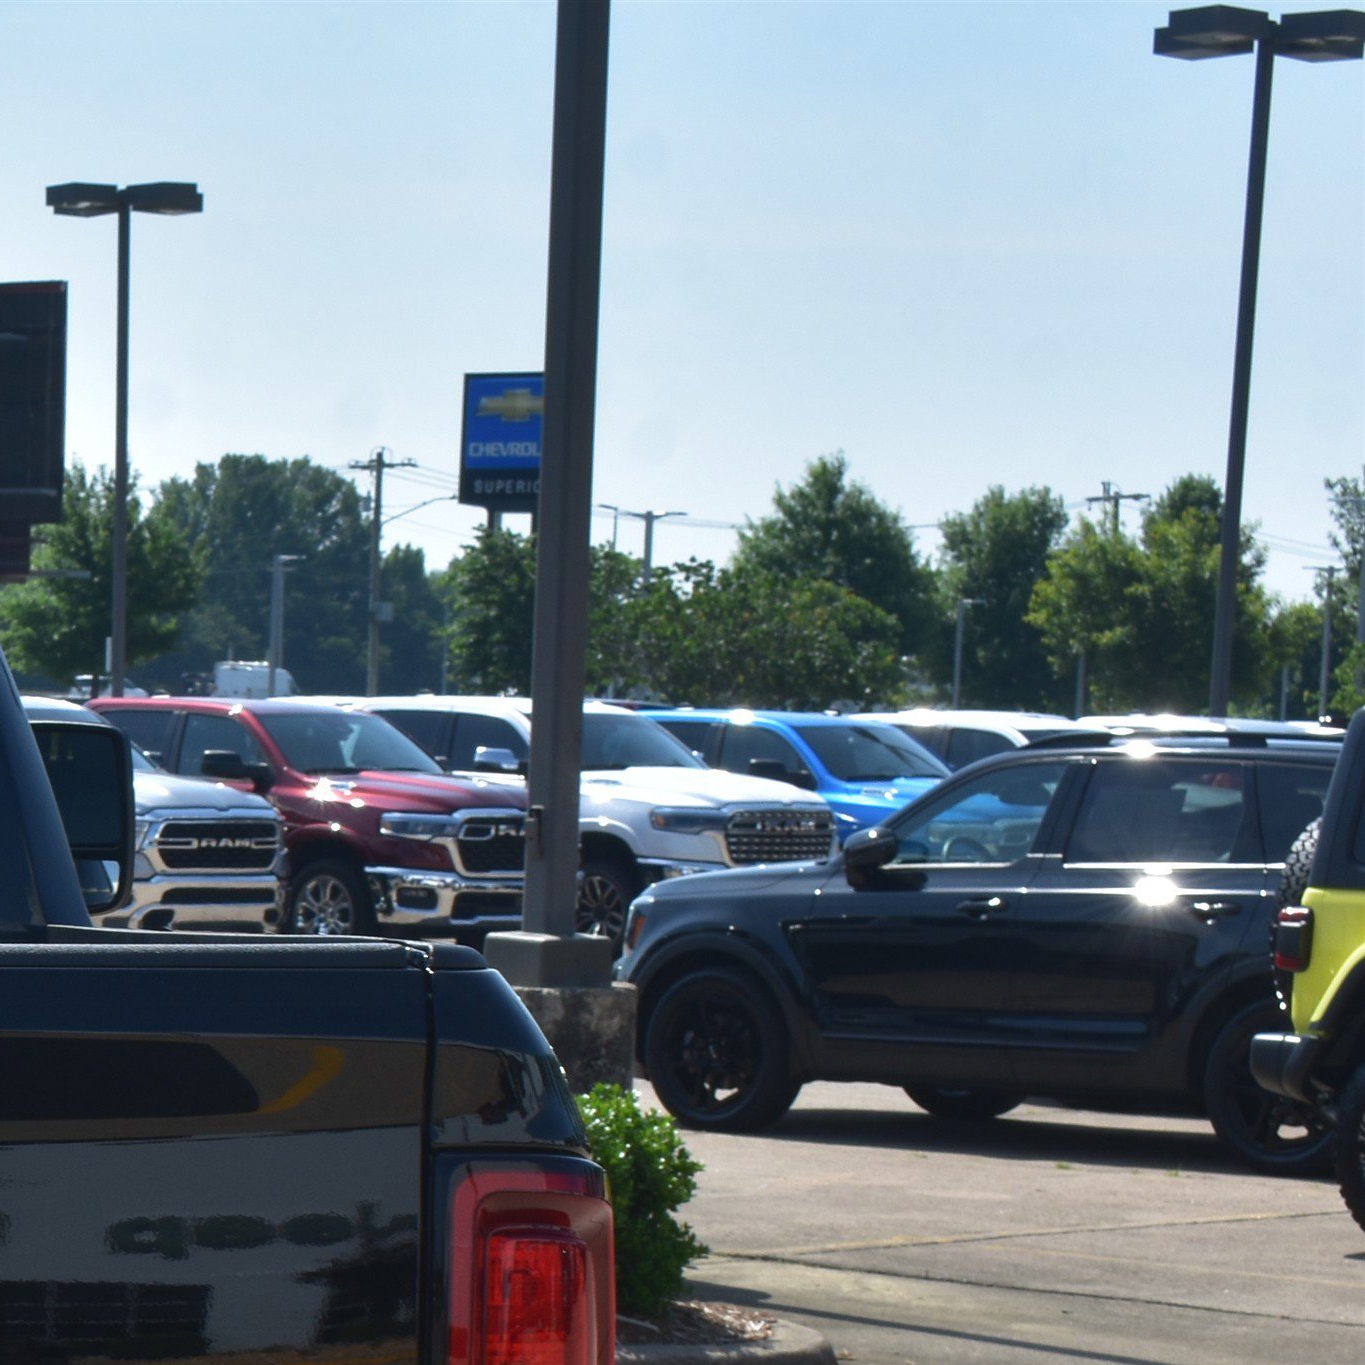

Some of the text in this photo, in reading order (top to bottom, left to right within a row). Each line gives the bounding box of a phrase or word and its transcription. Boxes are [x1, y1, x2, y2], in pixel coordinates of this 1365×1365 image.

[469, 442, 542, 457] CHEVROL
[474, 480, 541, 494] SUPERIO
[200, 838, 249, 848] RAM
